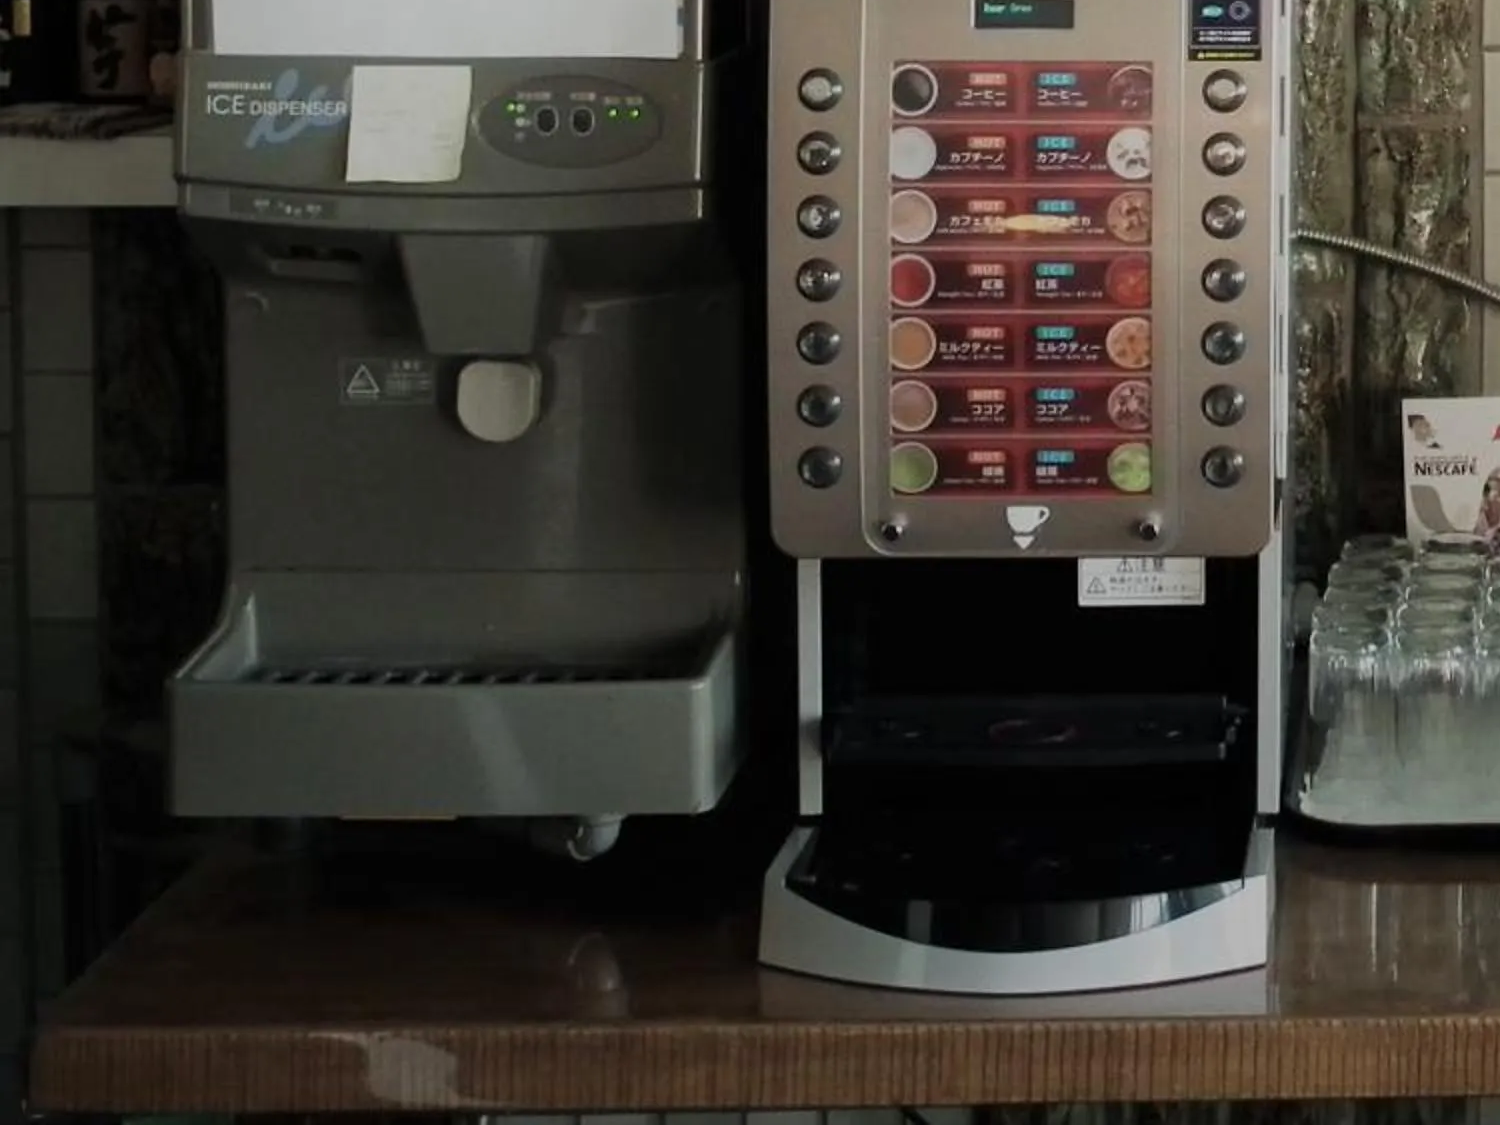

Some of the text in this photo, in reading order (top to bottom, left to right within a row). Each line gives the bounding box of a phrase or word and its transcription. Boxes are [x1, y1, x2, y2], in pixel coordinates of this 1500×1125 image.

[962, 89, 1007, 100] コーヒー
[1038, 89, 1083, 100] コーヒー
[207, 94, 347, 116] ICE DISPENSER
[939, 342, 1004, 353] ミルクティー
[1036, 342, 1101, 353] ミルクティー
[972, 404, 1005, 415] ココア
[1036, 404, 1069, 415] ココア
